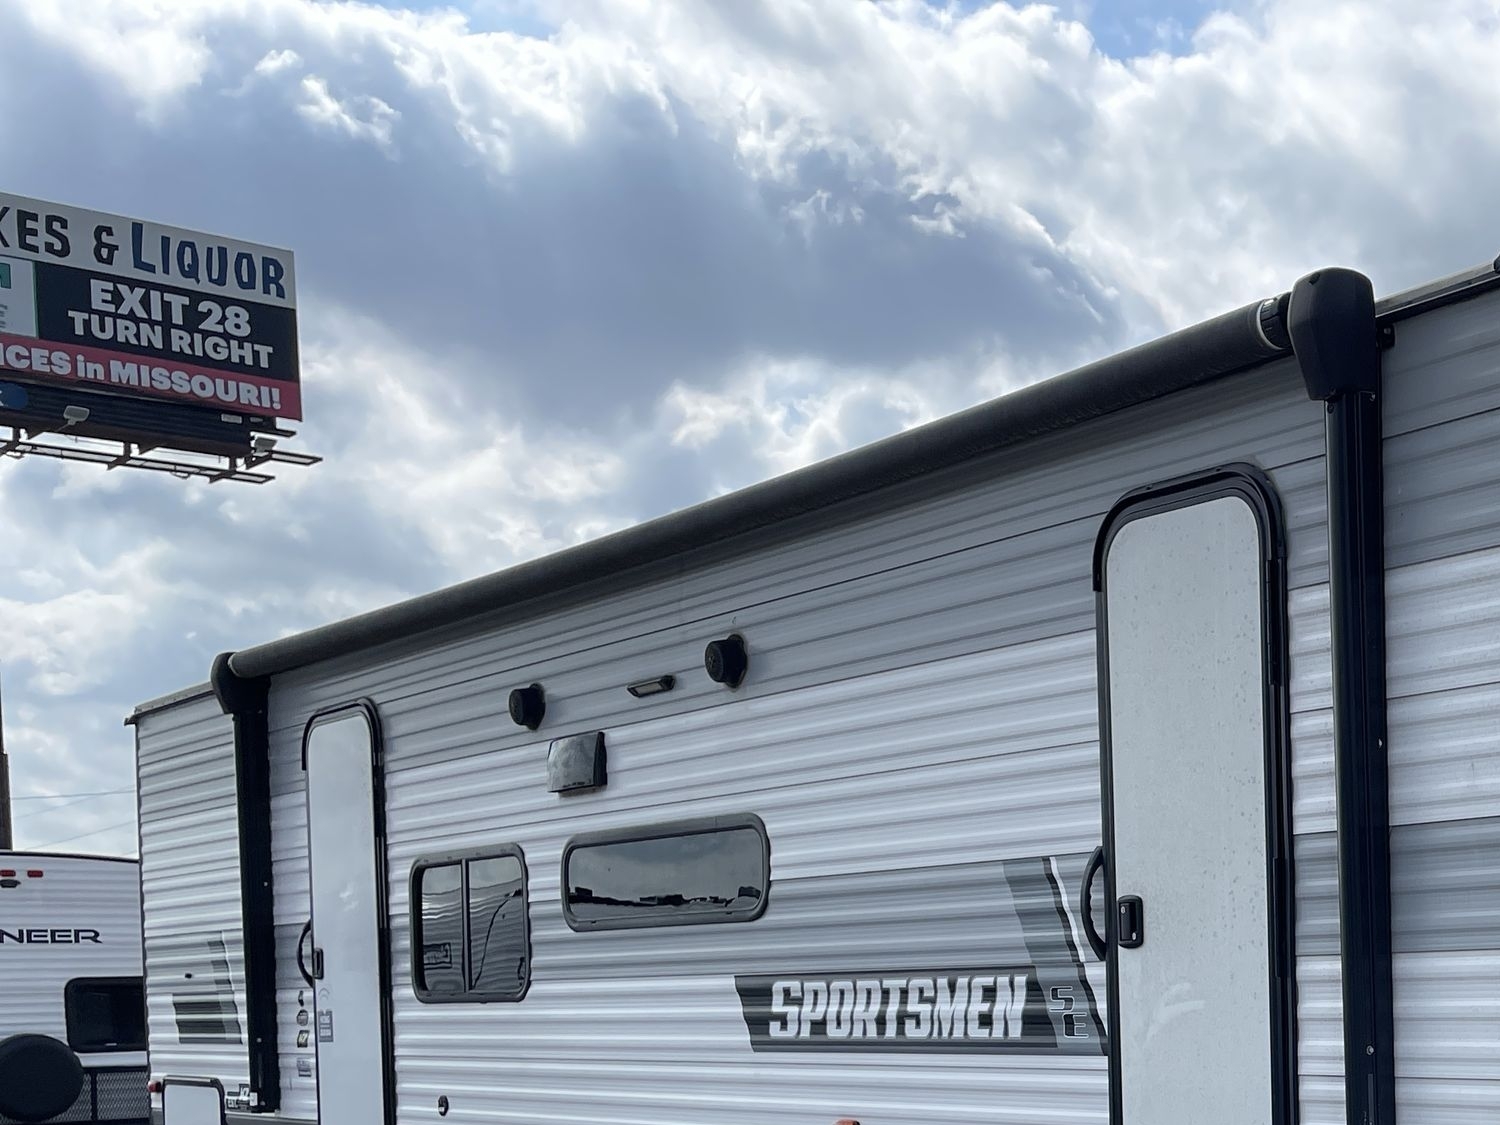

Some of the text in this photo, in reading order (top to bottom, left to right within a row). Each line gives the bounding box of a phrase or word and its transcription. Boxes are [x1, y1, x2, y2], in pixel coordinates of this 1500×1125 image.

[93, 225, 119, 265] &
[131, 221, 286, 299] LIQUOR
[89, 278, 252, 337] EXIT 28
[67, 310, 274, 369] TURN RIGHT
[76, 354, 105, 381] in
[109, 359, 282, 410] MISSOURI!
[0, 929, 103, 944] NEER
[769, 974, 1029, 1040] SPORTSMEN
